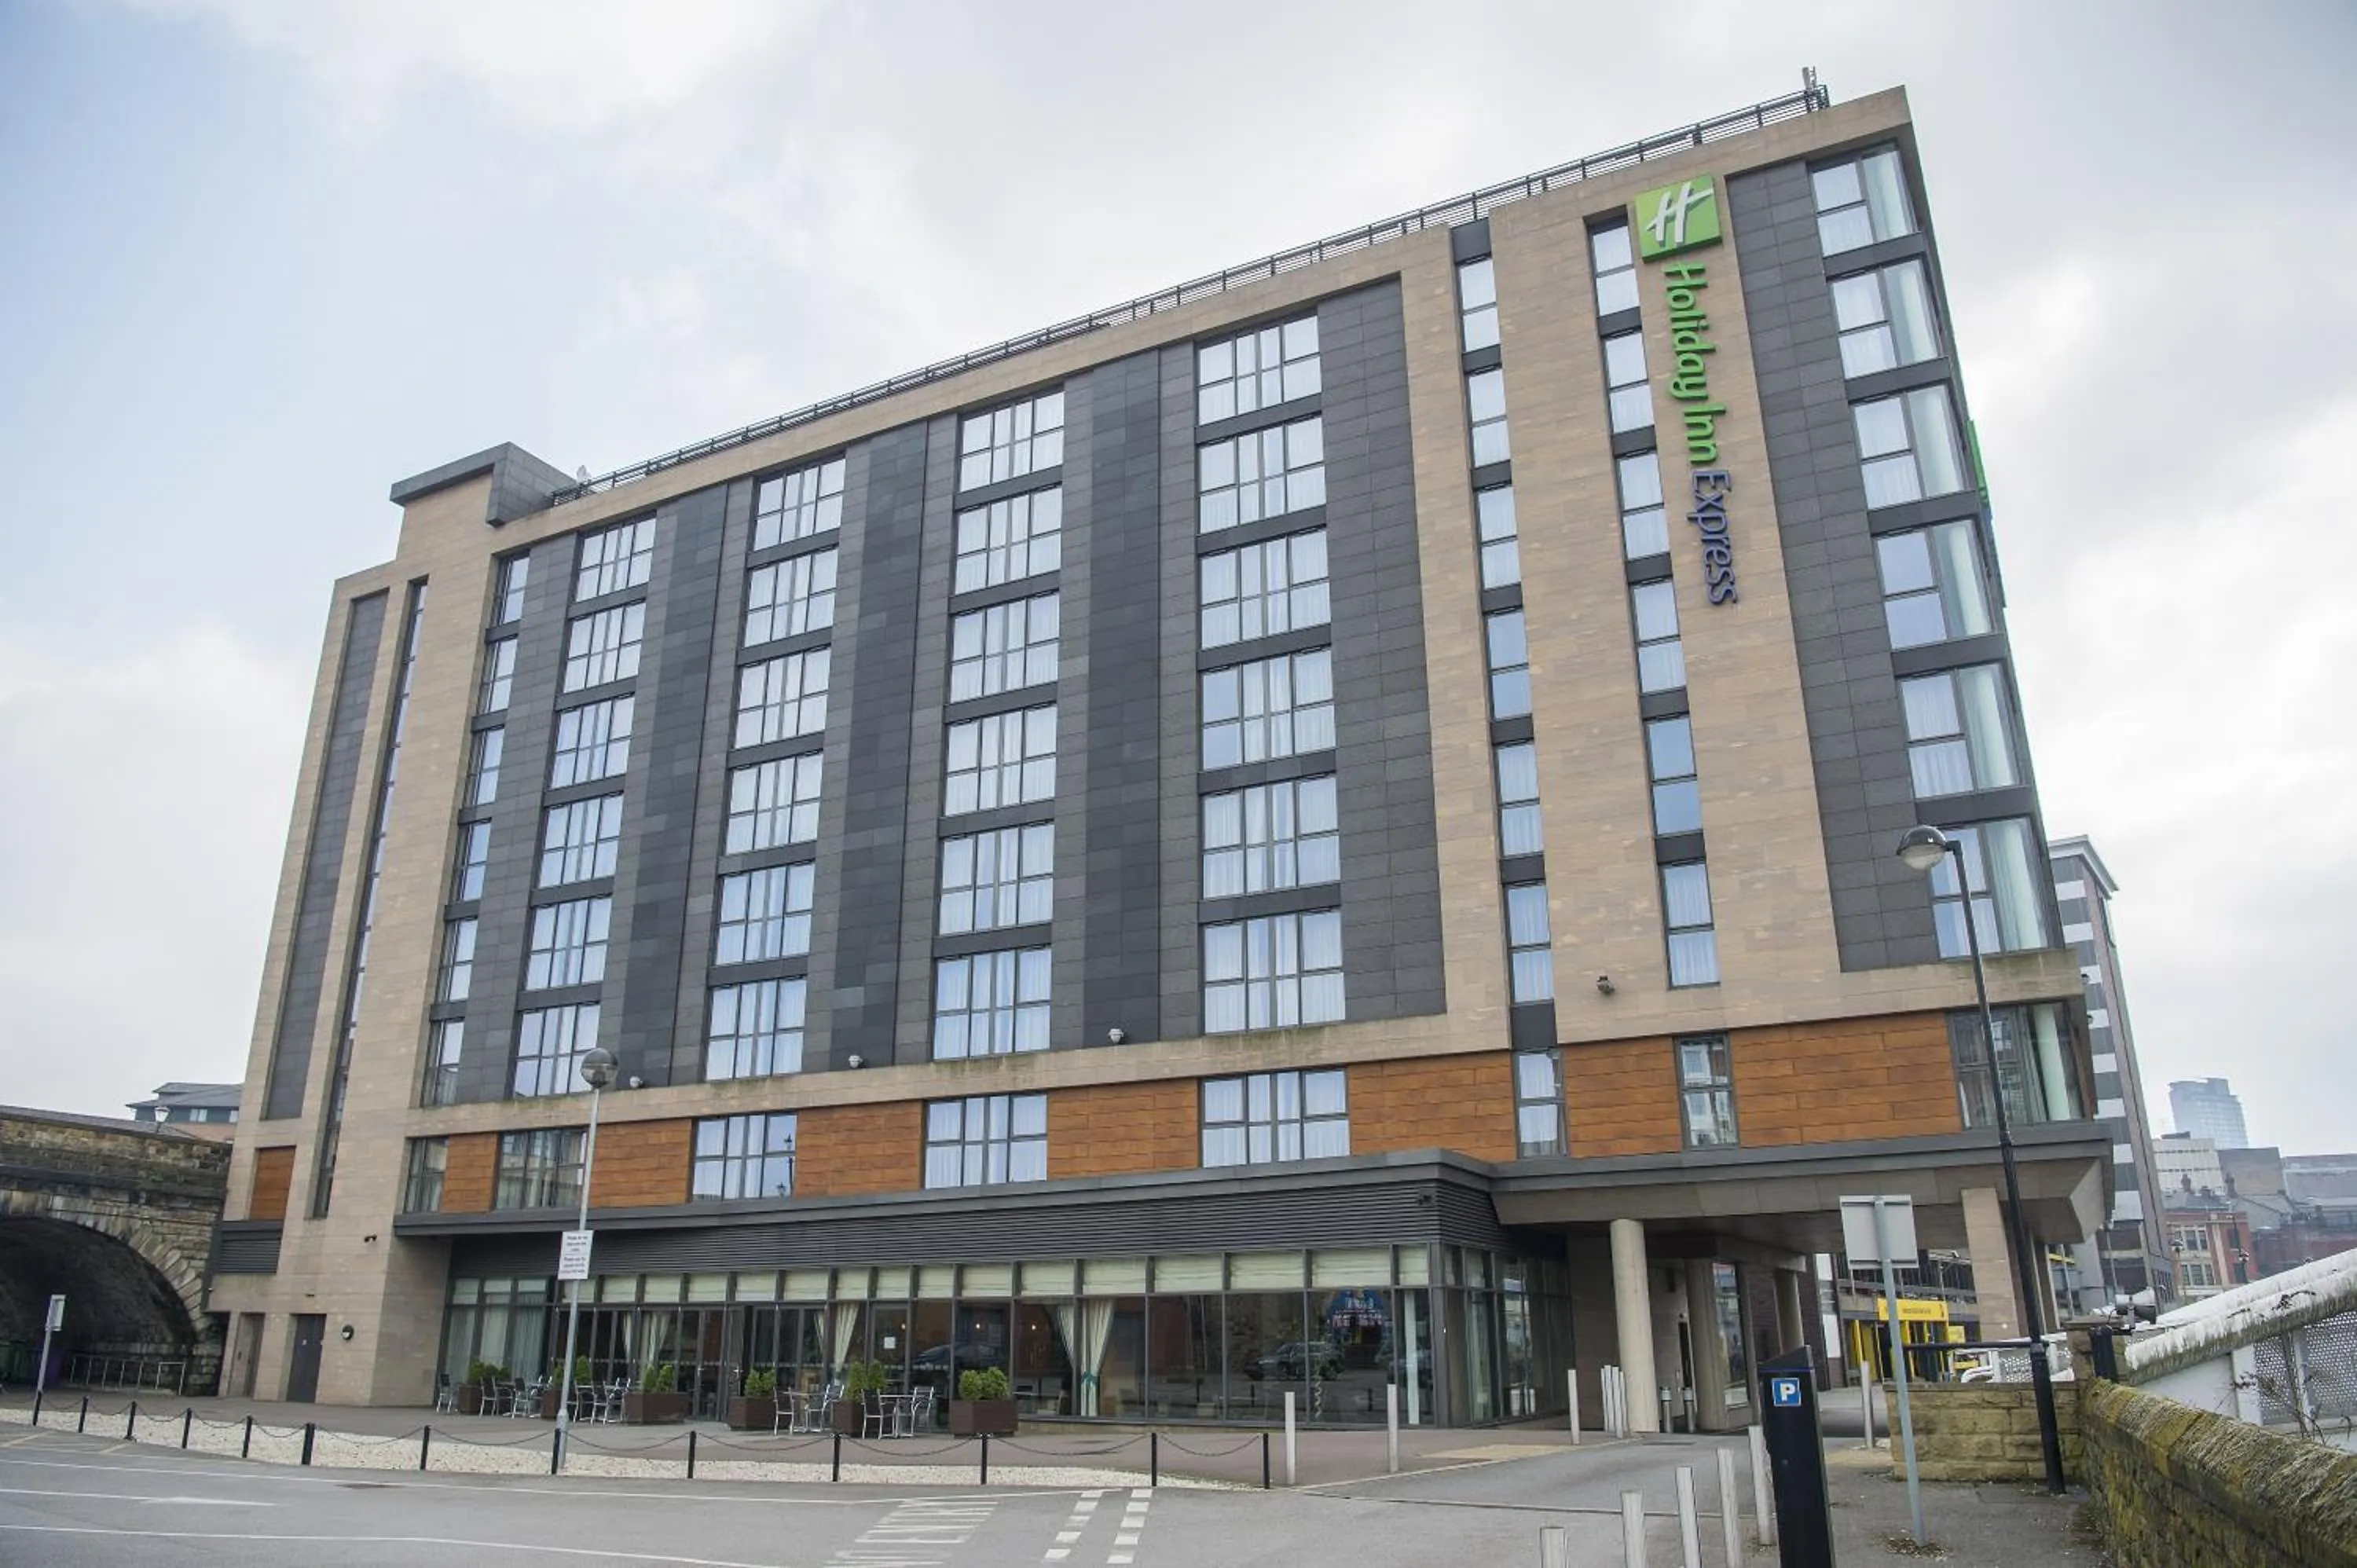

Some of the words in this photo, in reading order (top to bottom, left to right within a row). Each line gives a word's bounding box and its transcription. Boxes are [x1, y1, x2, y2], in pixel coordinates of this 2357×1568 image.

[1662, 262, 1717, 401] Holiday
[1683, 403, 1726, 464] Inn
[1688, 470, 1738, 606] Express
[1780, 1383, 1795, 1401] P
